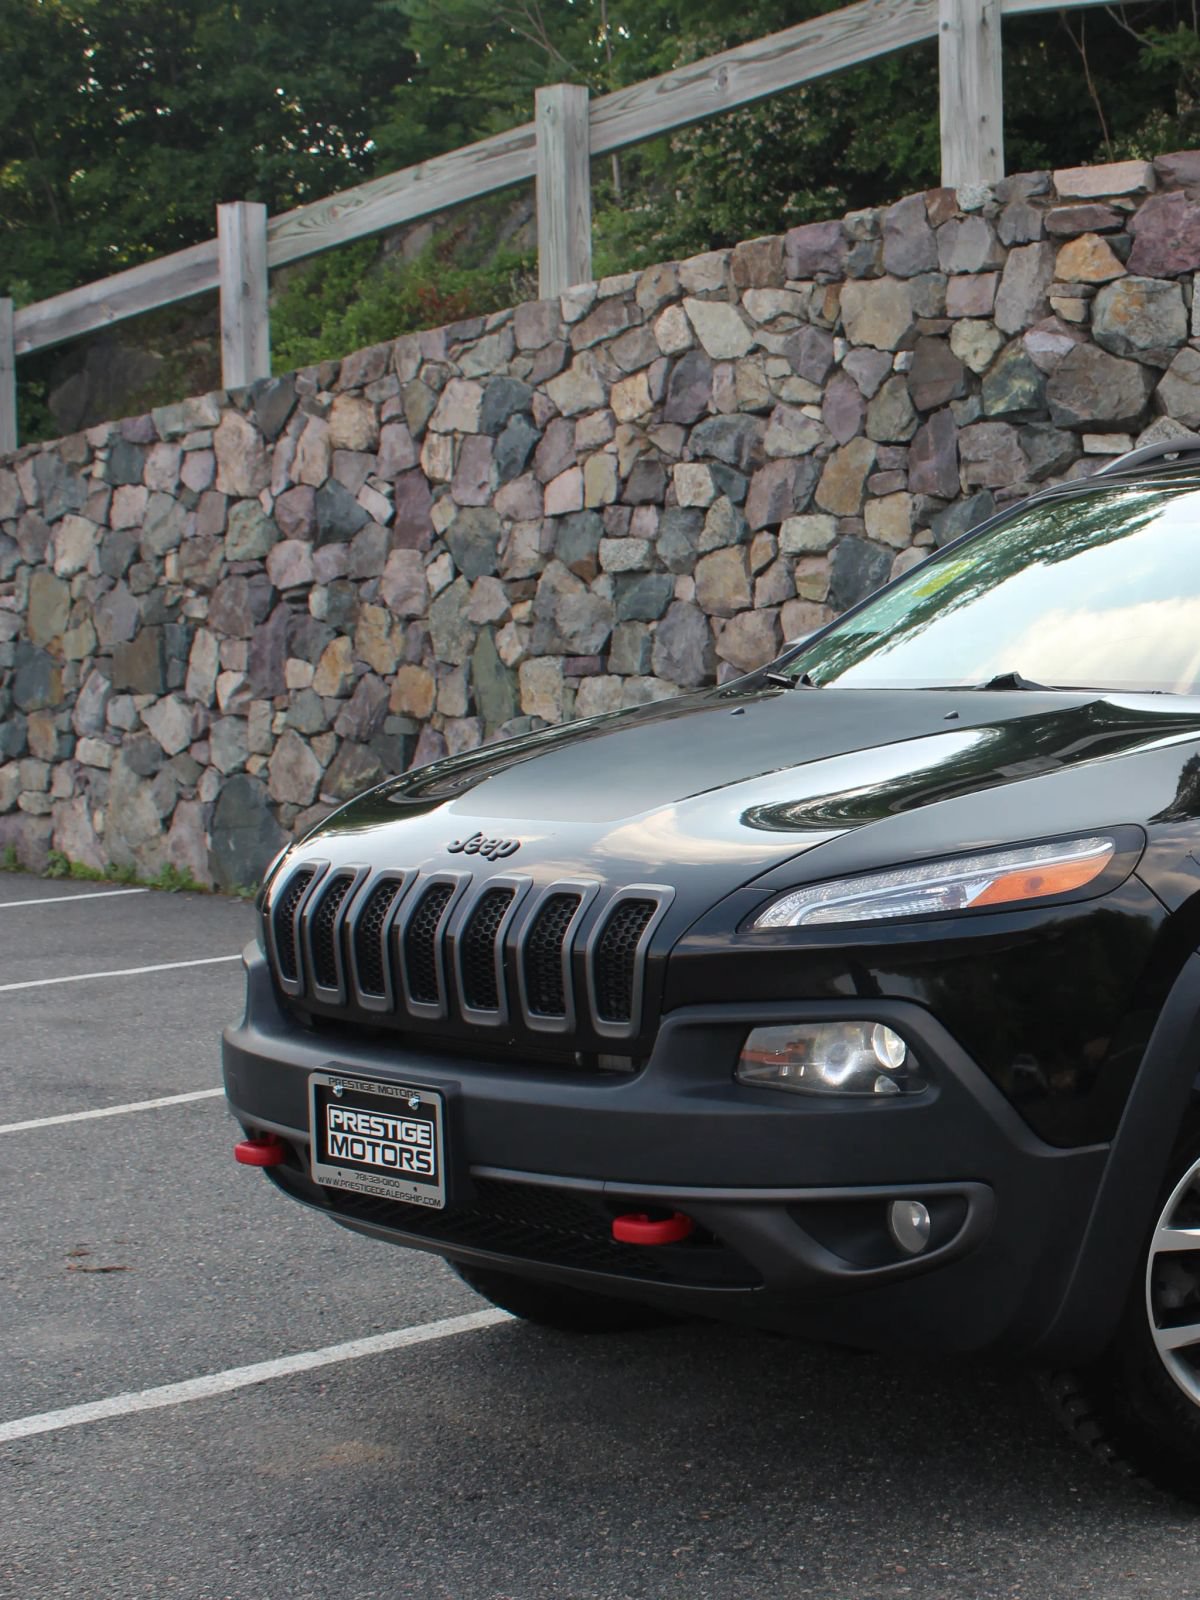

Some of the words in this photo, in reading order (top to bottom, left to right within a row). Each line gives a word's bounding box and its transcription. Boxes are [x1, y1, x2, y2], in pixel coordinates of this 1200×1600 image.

[447, 831, 521, 861] Jeep
[328, 1077, 376, 1092] PRESTIGE
[329, 1108, 431, 1146] PRESTIGE
[330, 1133, 432, 1173] MOTORS
